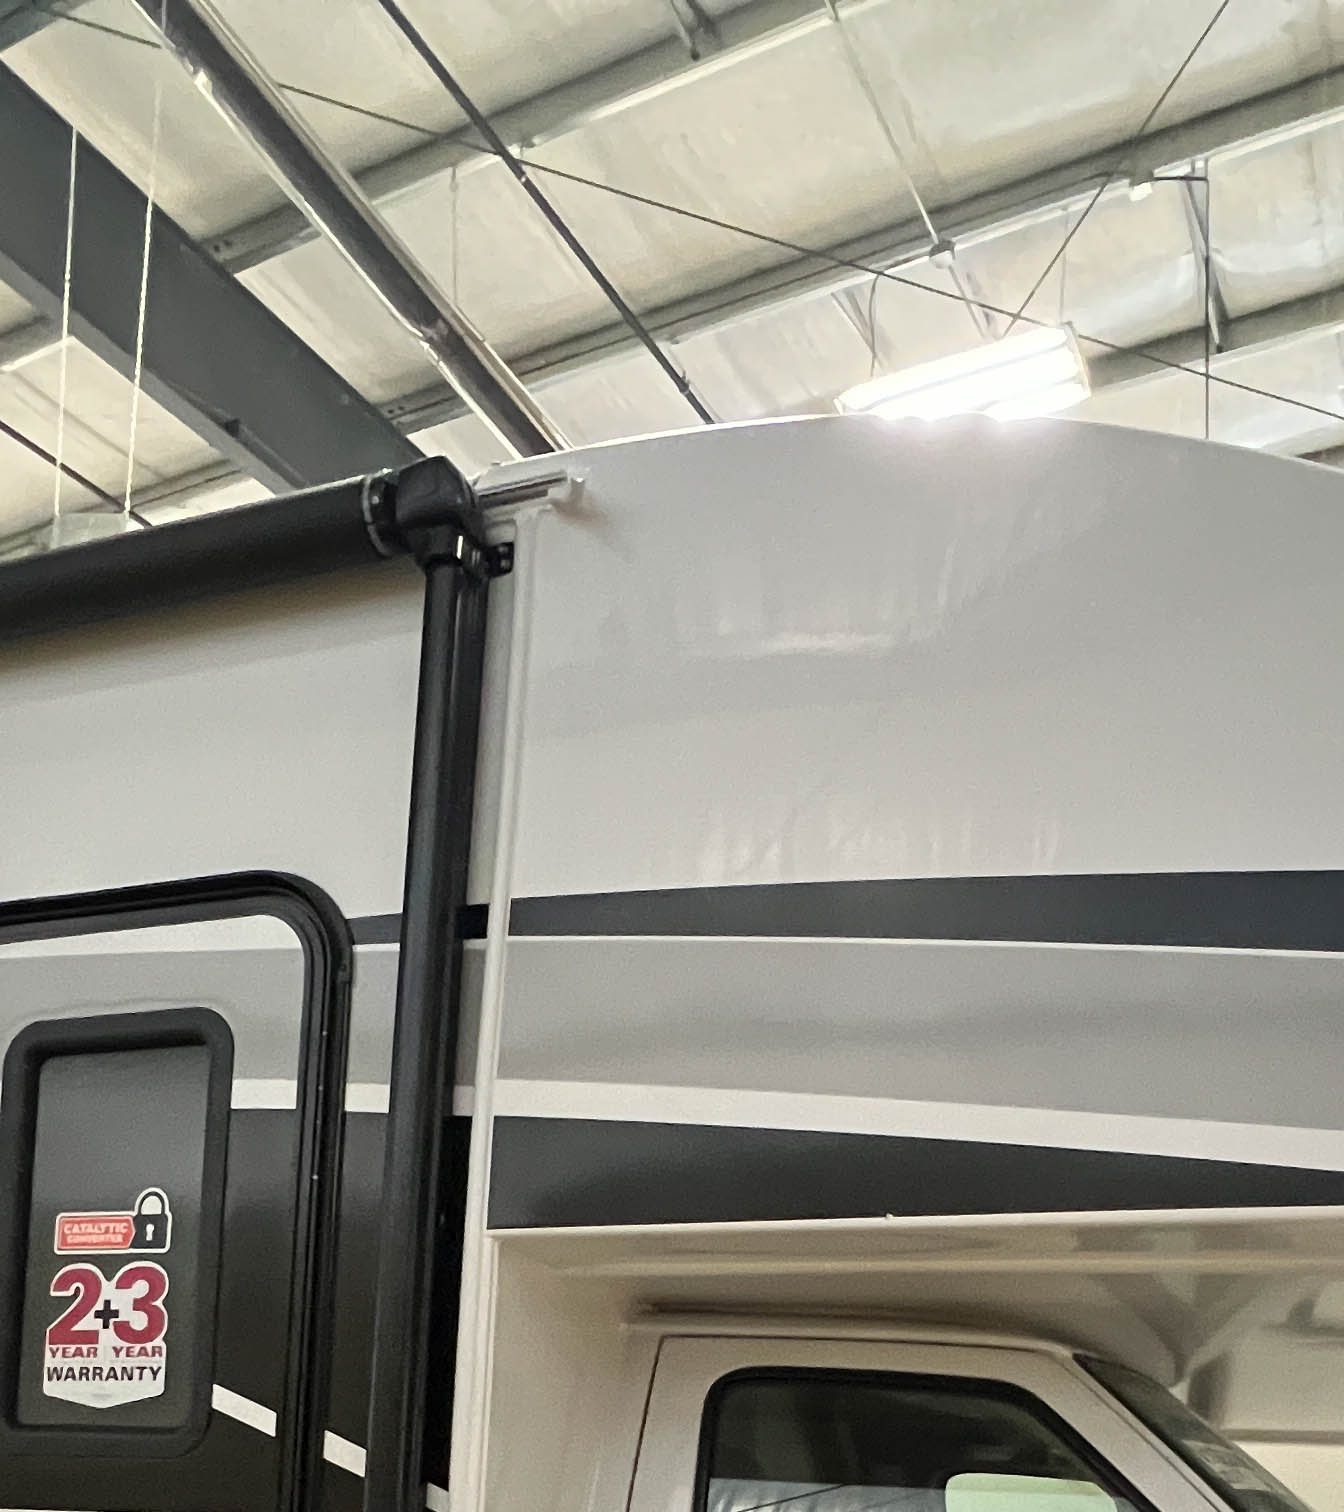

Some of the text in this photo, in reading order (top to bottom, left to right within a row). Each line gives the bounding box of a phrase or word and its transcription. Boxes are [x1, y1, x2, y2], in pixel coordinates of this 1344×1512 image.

[63, 1222, 129, 1234] CATALYTIC
[48, 1345, 163, 1358] YEAR YEAR
[46, 1366, 162, 1381] WARRANTY
